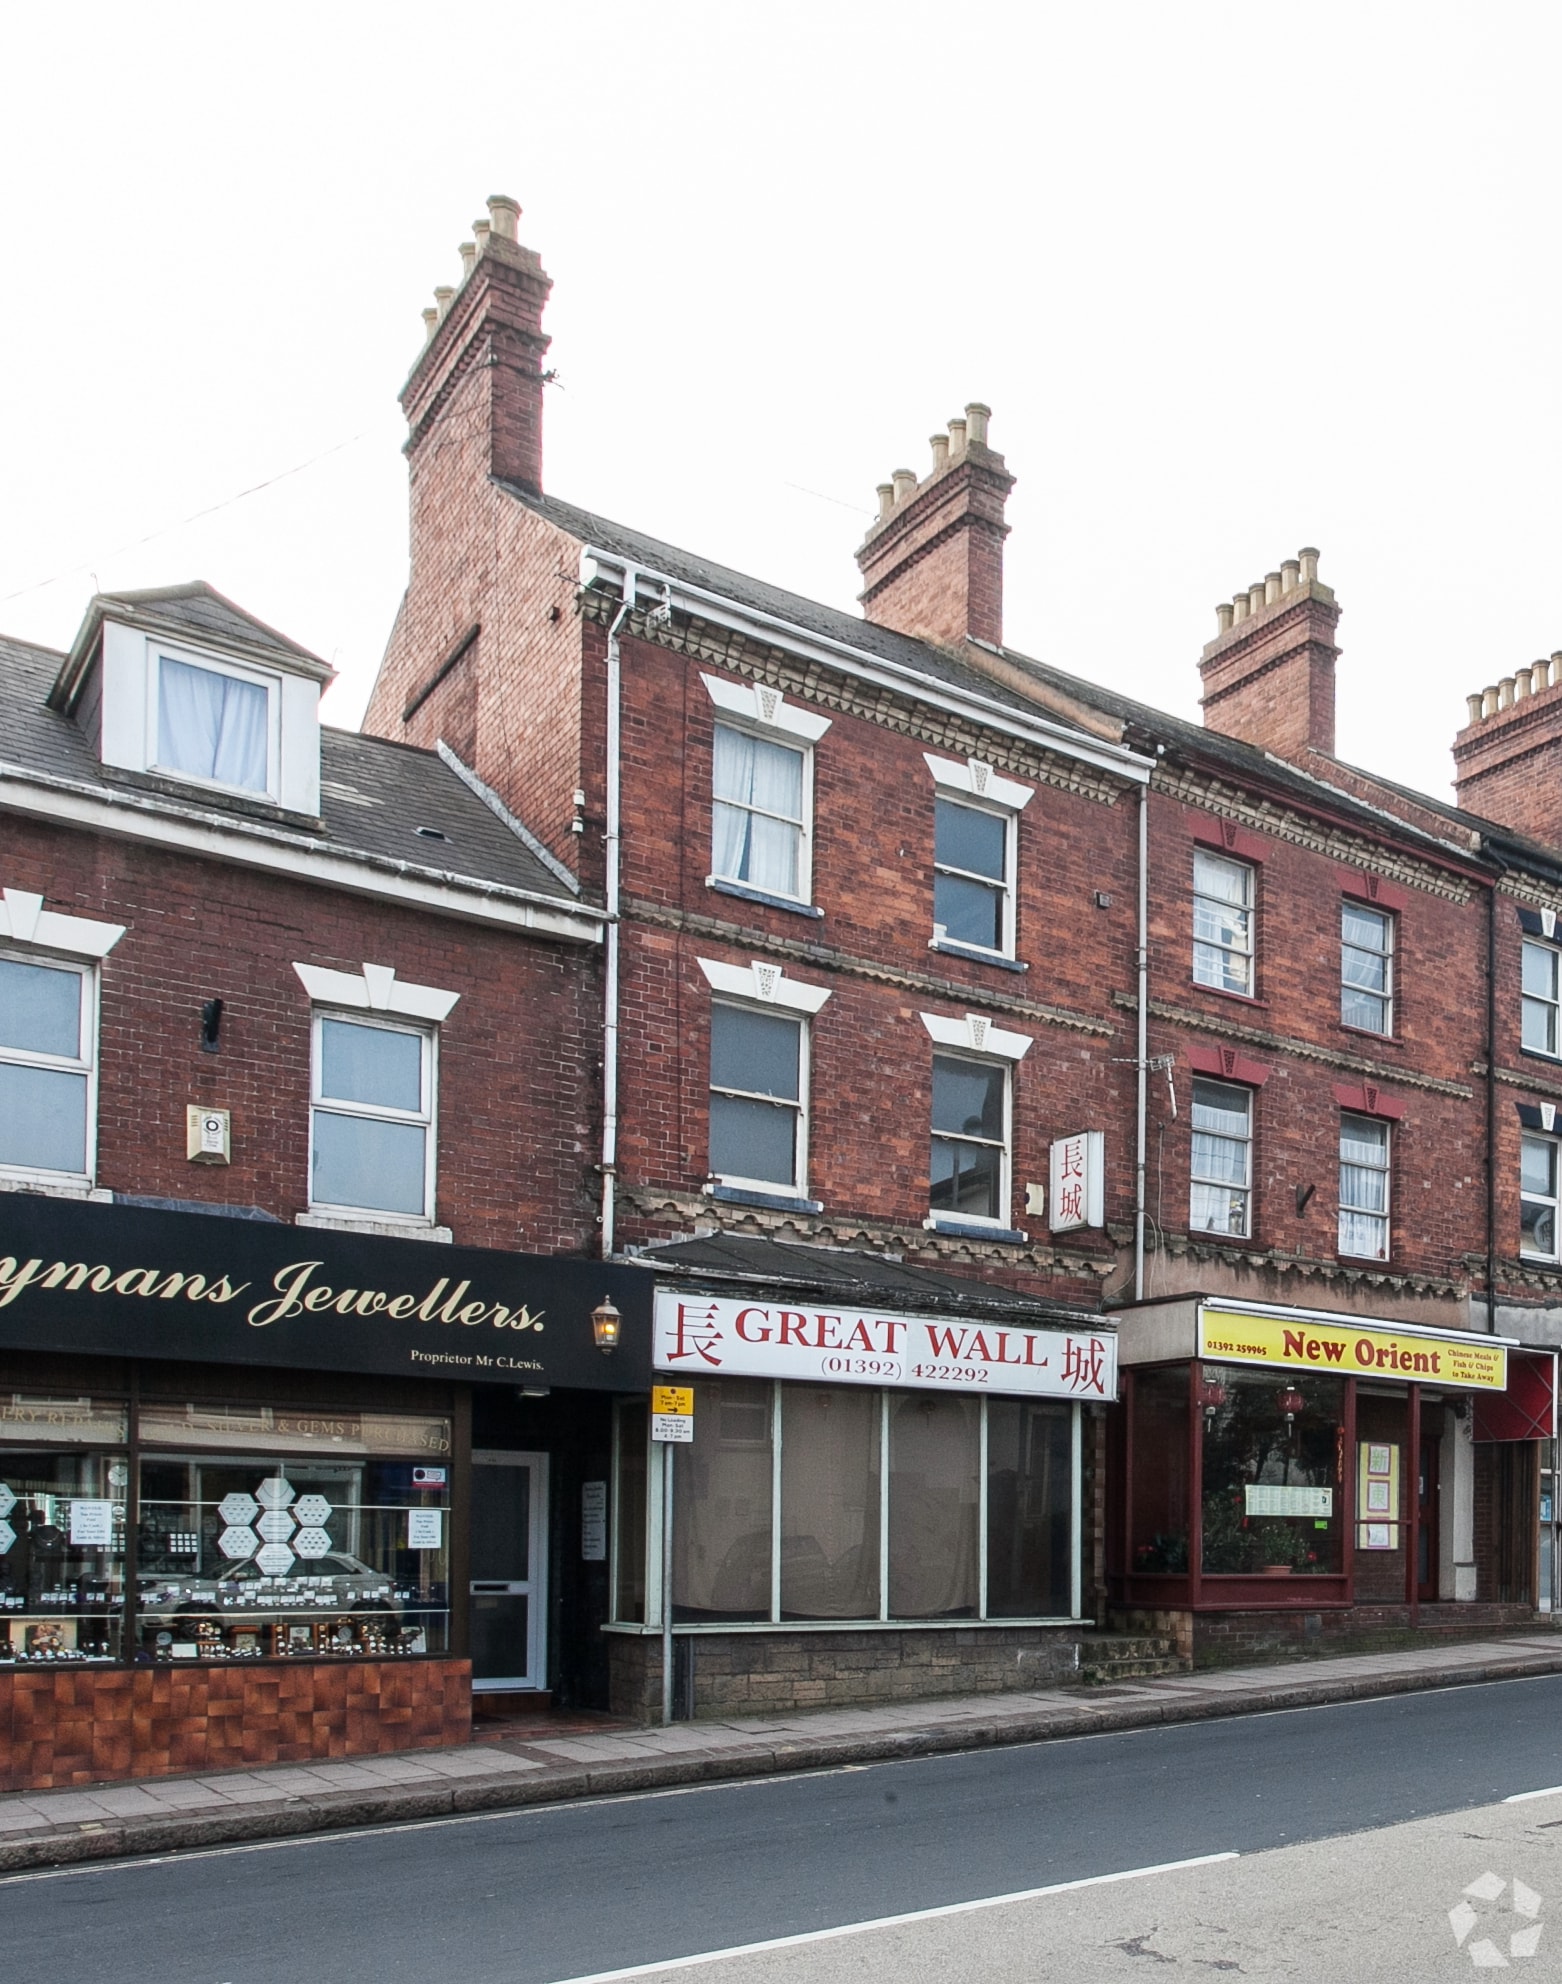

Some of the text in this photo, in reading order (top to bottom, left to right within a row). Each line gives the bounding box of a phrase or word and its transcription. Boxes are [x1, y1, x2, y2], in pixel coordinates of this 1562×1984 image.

[1060, 1139, 1083, 1224] 長城
[248, 1261, 546, 1332] Jewellers.
[410, 1349, 473, 1365] Proprietor
[476, 1354, 494, 1367] Mr
[665, 1303, 1105, 1394] 長 GREAT WALL 城
[1207, 1341, 1267, 1356] 01392 259965
[1283, 1329, 1441, 1374] New Orient
[1447, 1349, 1472, 1358] Chinese
[1474, 1352, 1492, 1361] Meals
[821, 1356, 989, 1383] (01392) 422292
[1453, 1360, 1467, 1368] Fish
[1475, 1362, 1494, 1371] Chips
[1460, 1371, 1475, 1379] Take
[1477, 1373, 1494, 1382] Away
[277, 1418, 291, 1433] &
[296, 1419, 345, 1436] GEMS
[350, 1418, 449, 1452] PURCHASED
